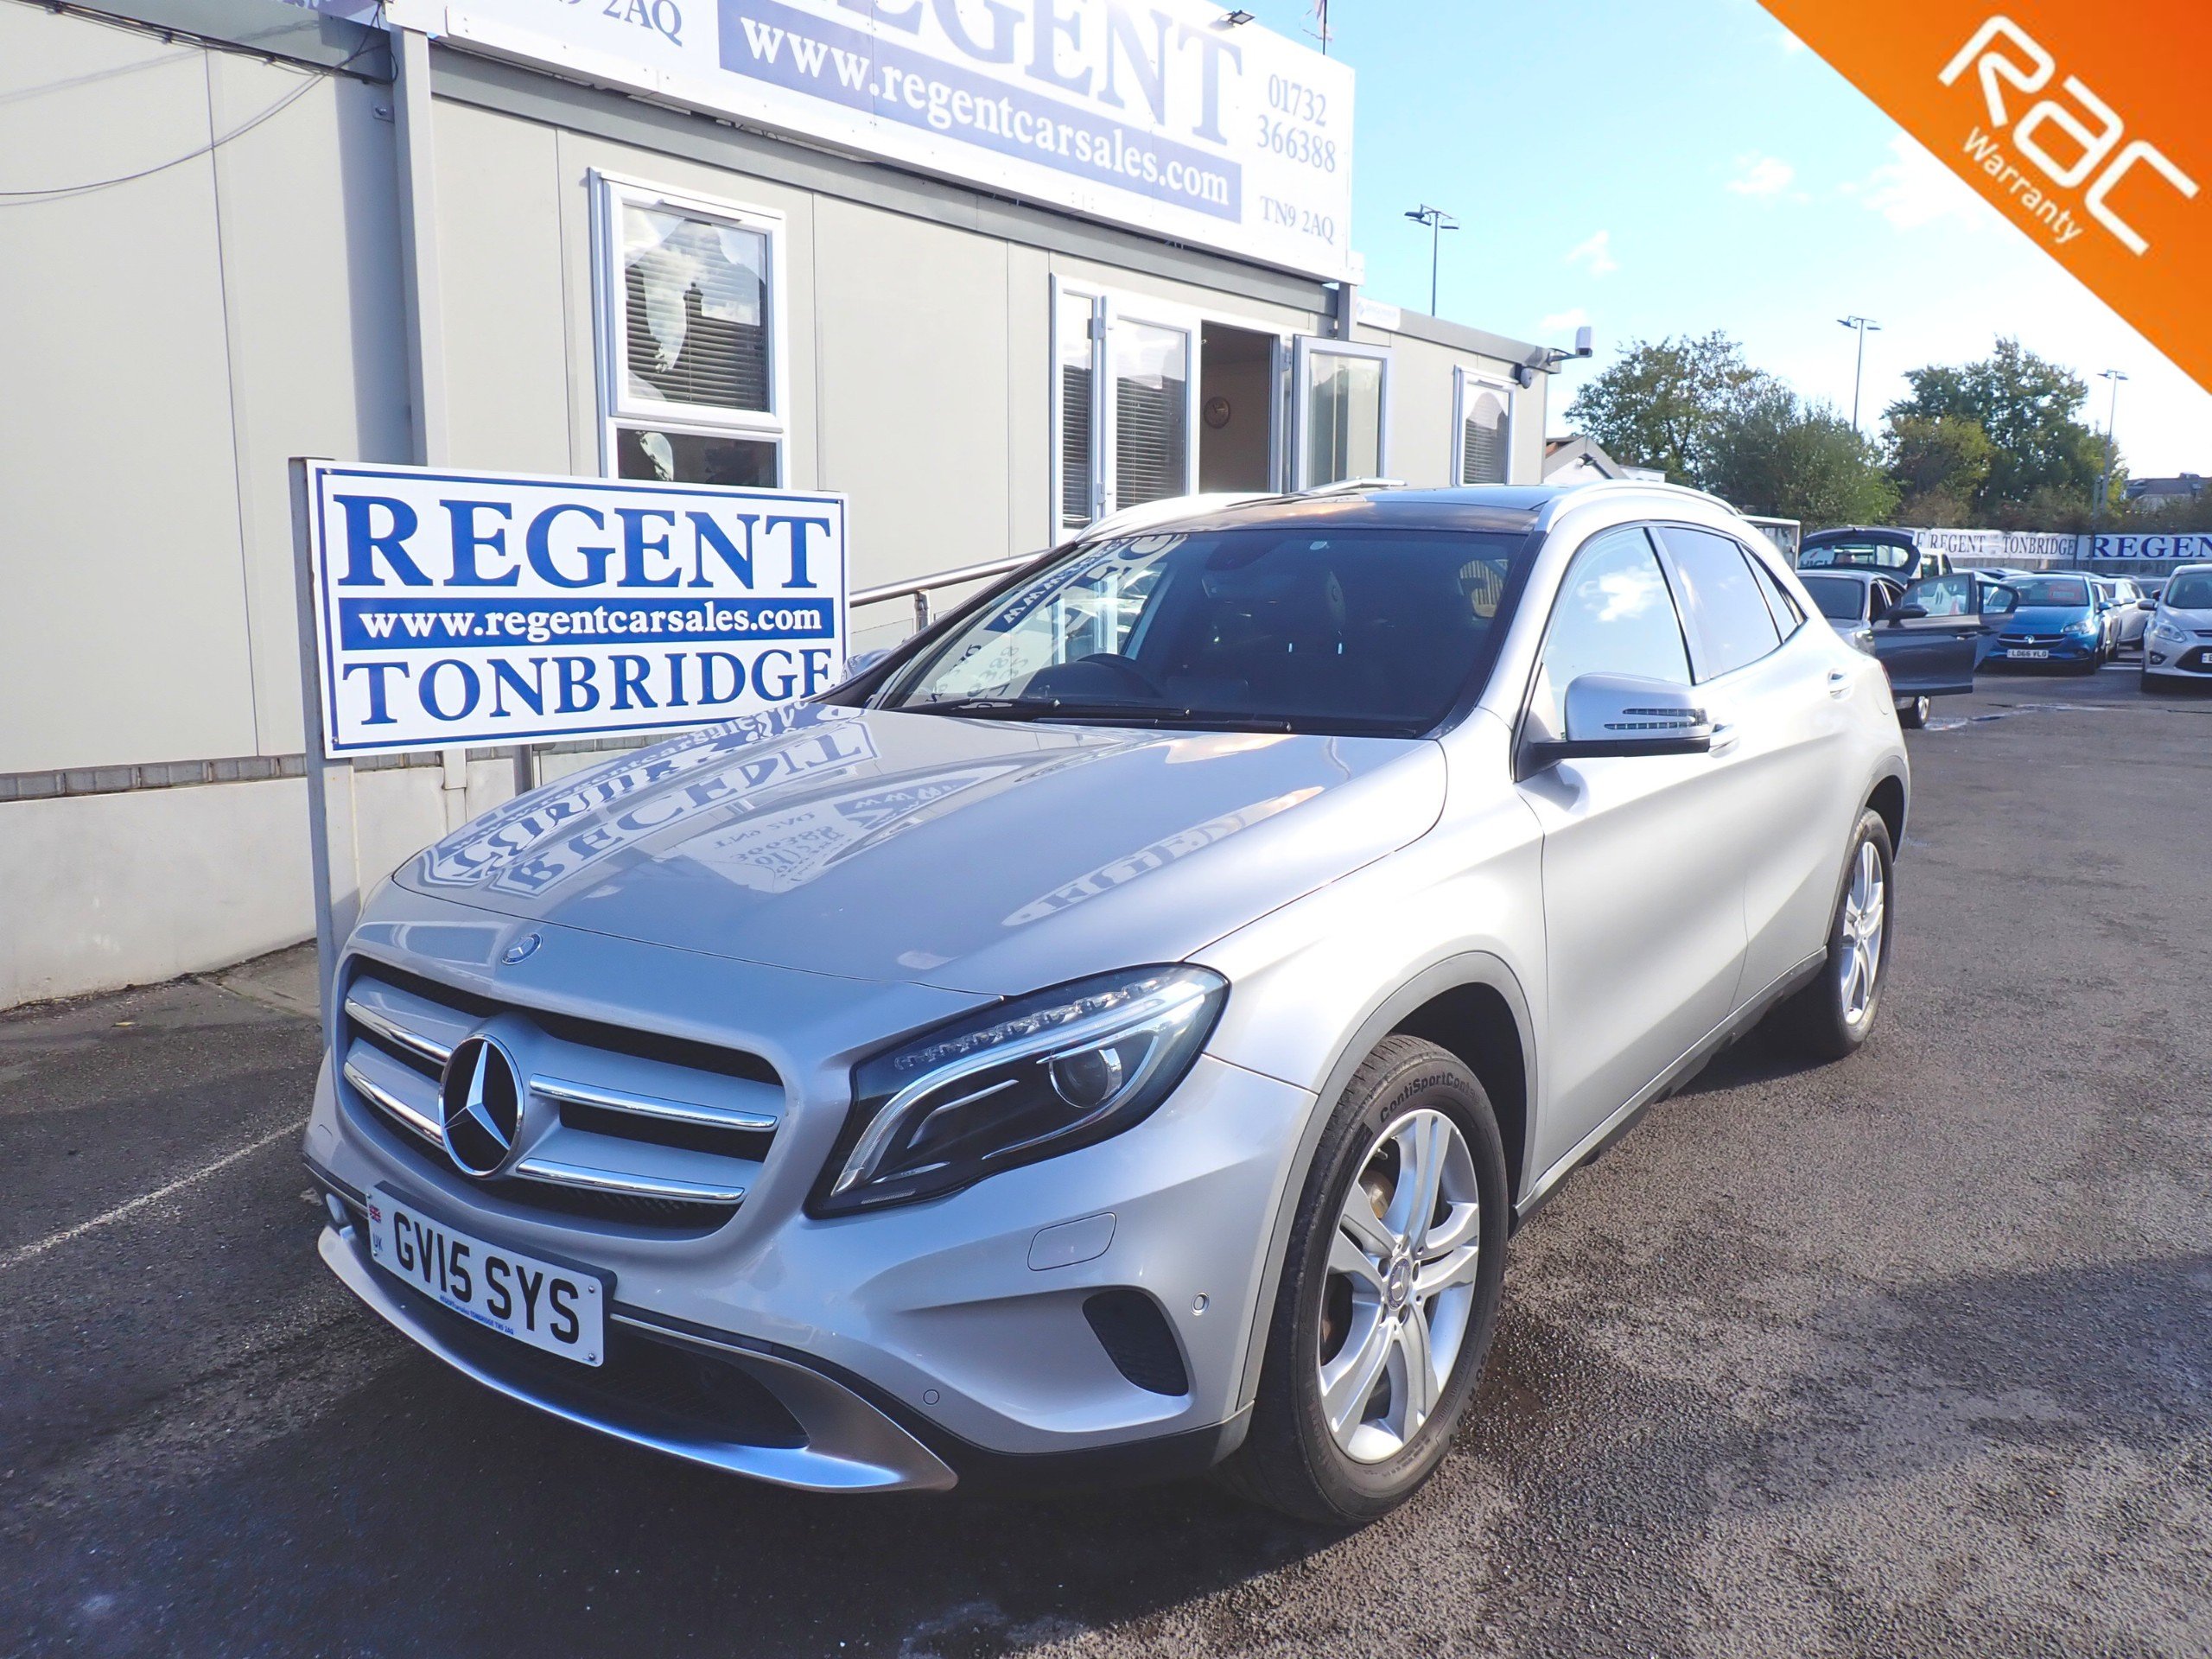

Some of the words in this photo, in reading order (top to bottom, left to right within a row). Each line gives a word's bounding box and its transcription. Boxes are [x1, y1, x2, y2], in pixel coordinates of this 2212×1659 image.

[741, 17, 1228, 206] www.regentcarsales.com
[1268, 73, 1326, 127] 01732
[1257, 114, 1335, 173] 366388
[1260, 195, 1296, 227] TN9
[1302, 210, 1333, 245] 2AQ
[333, 493, 832, 589] REGENT
[1930, 533, 1986, 553] REGENT
[2002, 536, 2074, 556] TONBRIDGE
[359, 601, 822, 643] www.regentcarsales.com
[342, 647, 836, 725] TONBRIDGE
[394, 1211, 473, 1303] GV15
[485, 1255, 580, 1345] SYS
